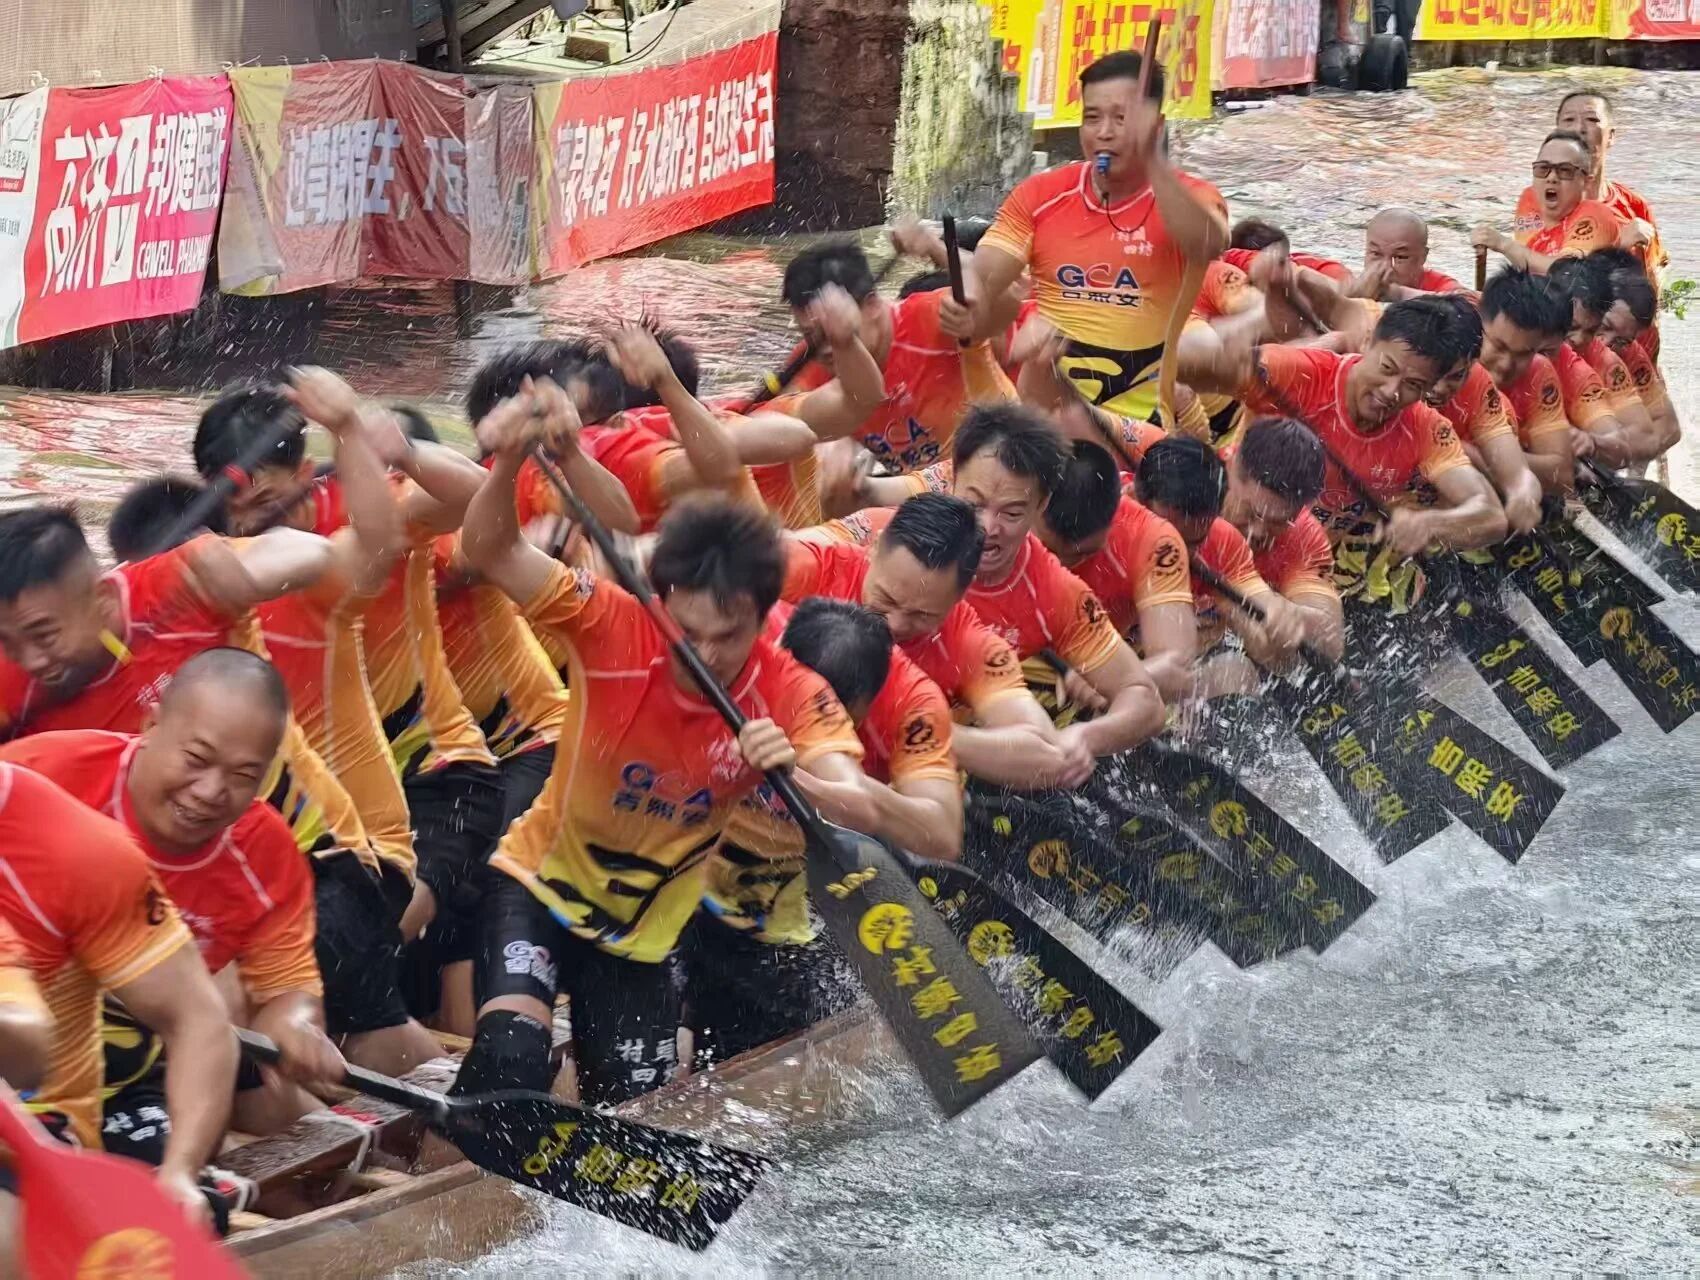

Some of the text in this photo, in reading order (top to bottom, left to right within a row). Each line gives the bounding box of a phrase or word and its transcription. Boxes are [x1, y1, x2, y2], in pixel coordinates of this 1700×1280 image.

[136, 240, 175, 280] COWELL
[1056, 263, 1141, 291] GCA
[1479, 638, 1526, 670] GCA
[1506, 662, 1583, 742] 吉熙安
[1427, 735, 1525, 824] 吉熙安
